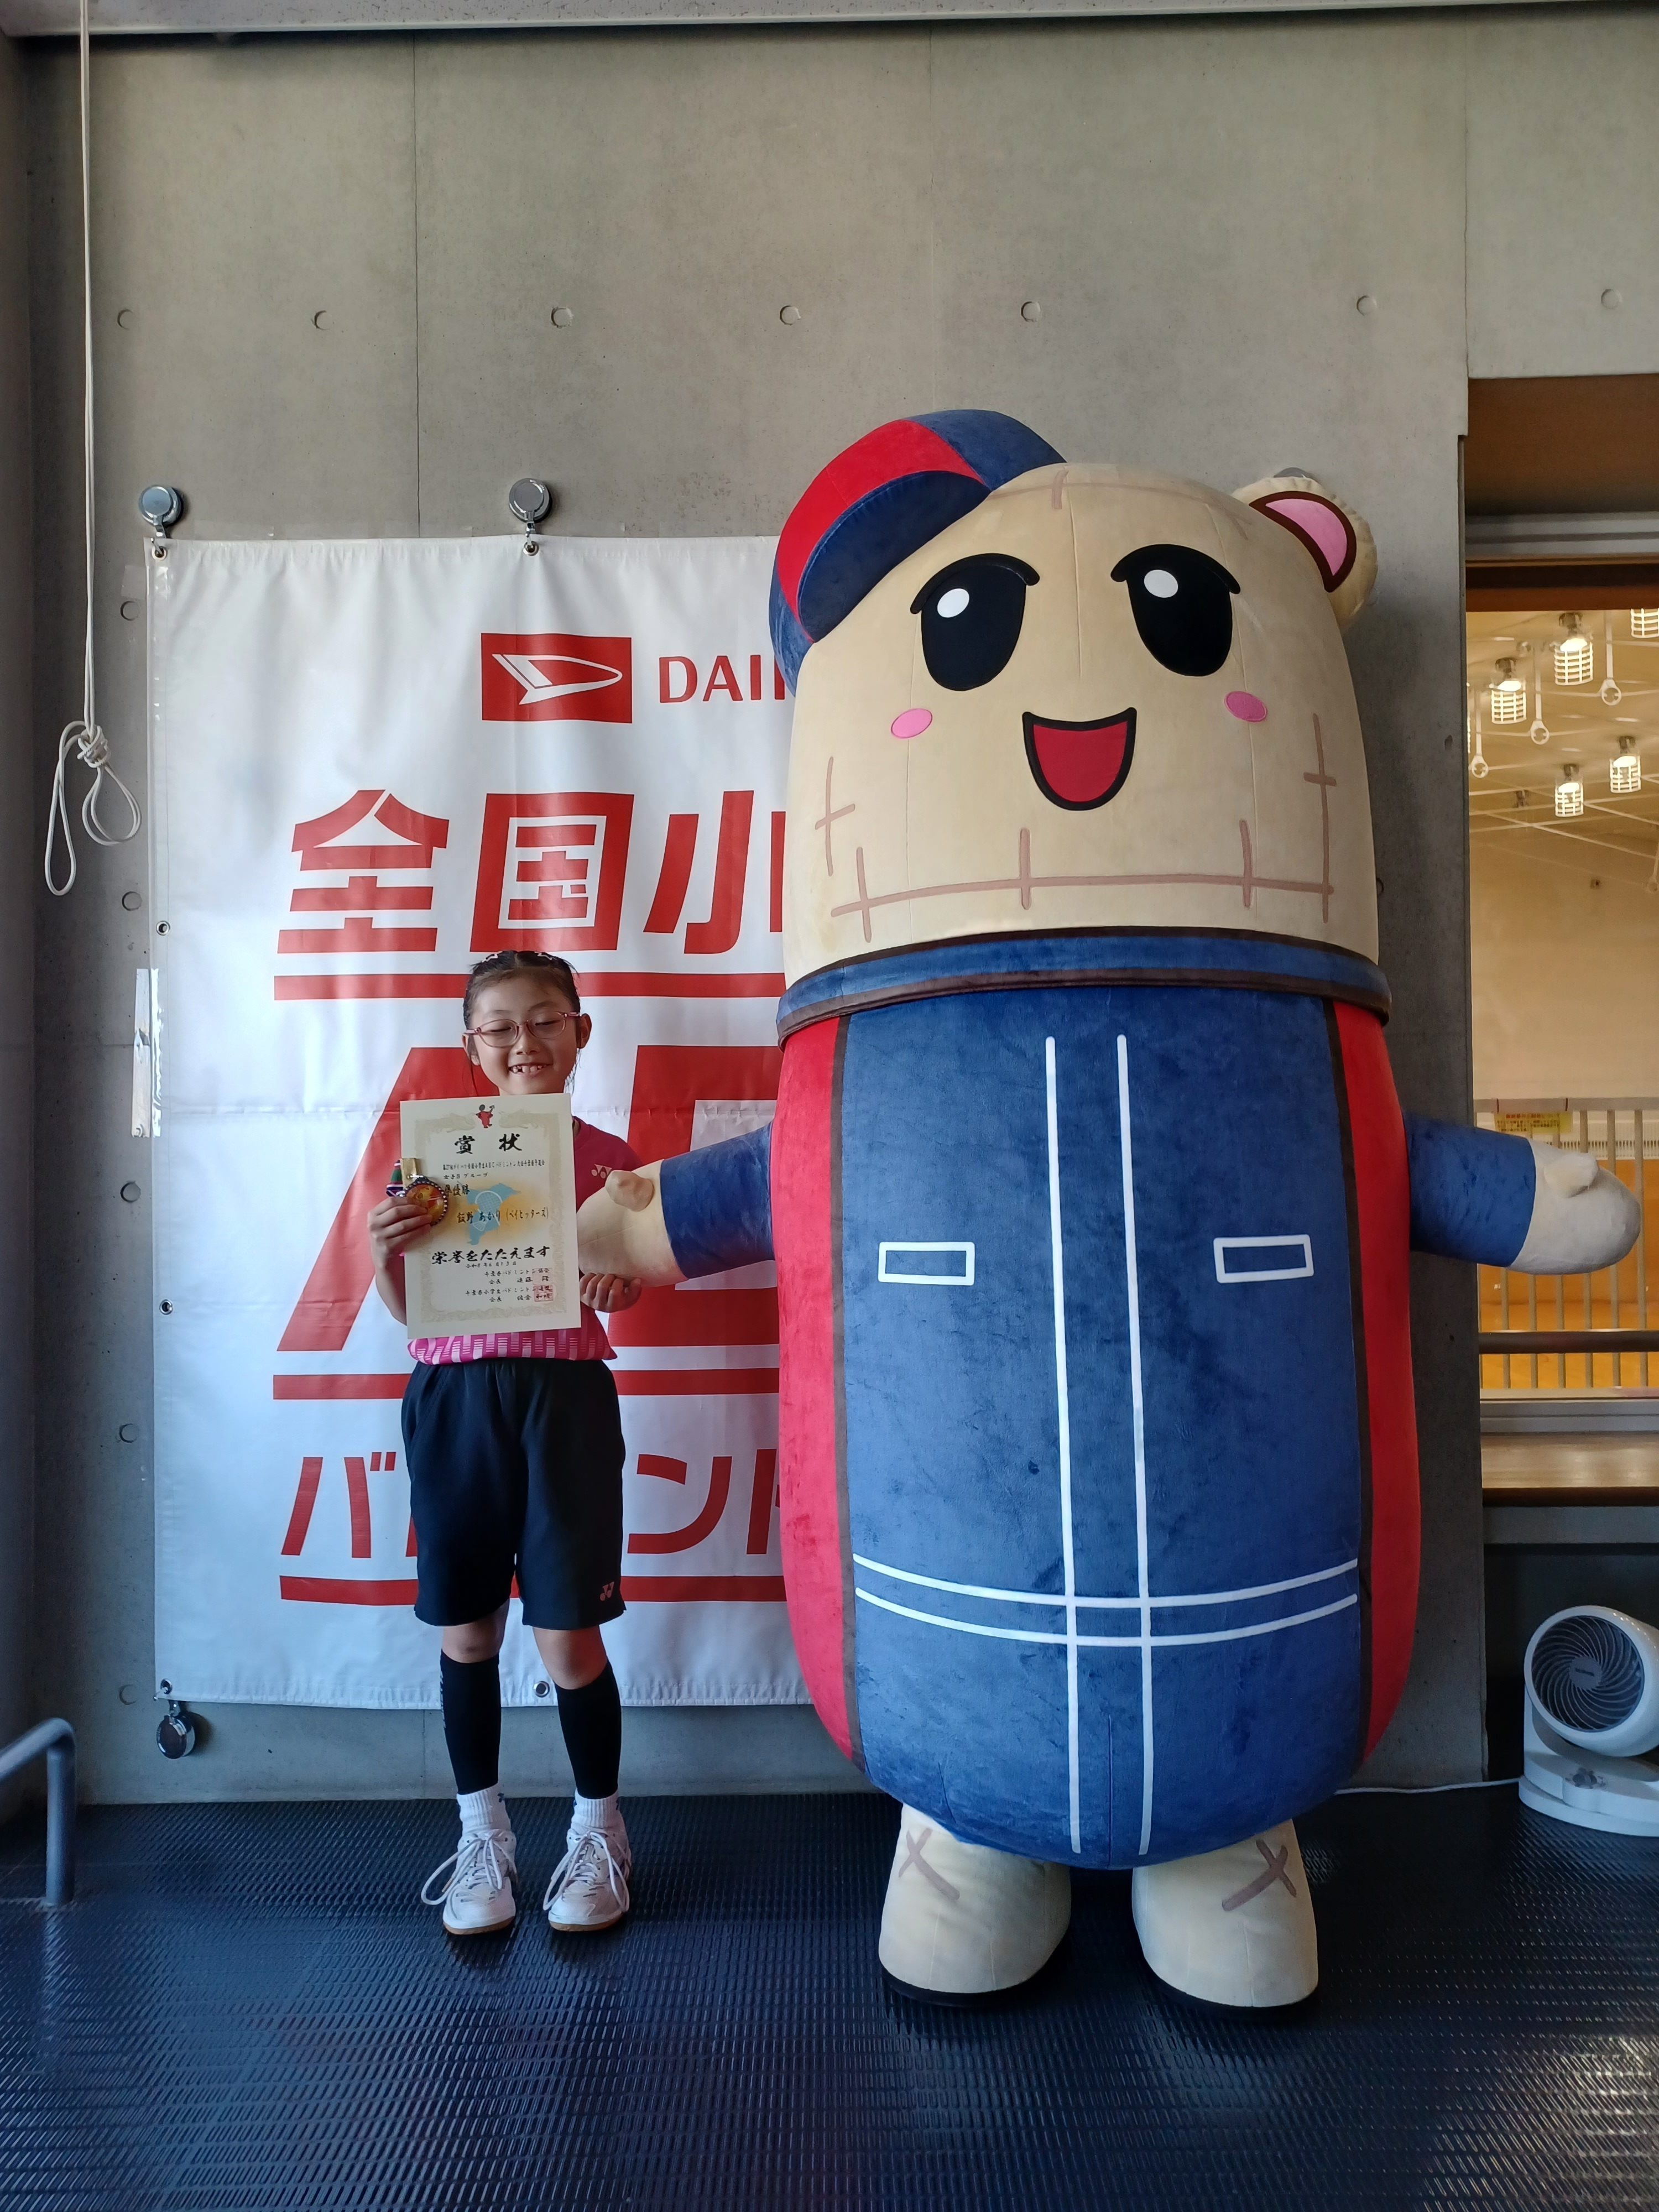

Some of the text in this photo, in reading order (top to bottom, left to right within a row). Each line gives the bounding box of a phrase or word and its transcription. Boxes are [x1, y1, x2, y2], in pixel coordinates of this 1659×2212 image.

[277, 790, 786, 954] 全国小
[431, 1245, 550, 1265] 栄誉をたたえます
